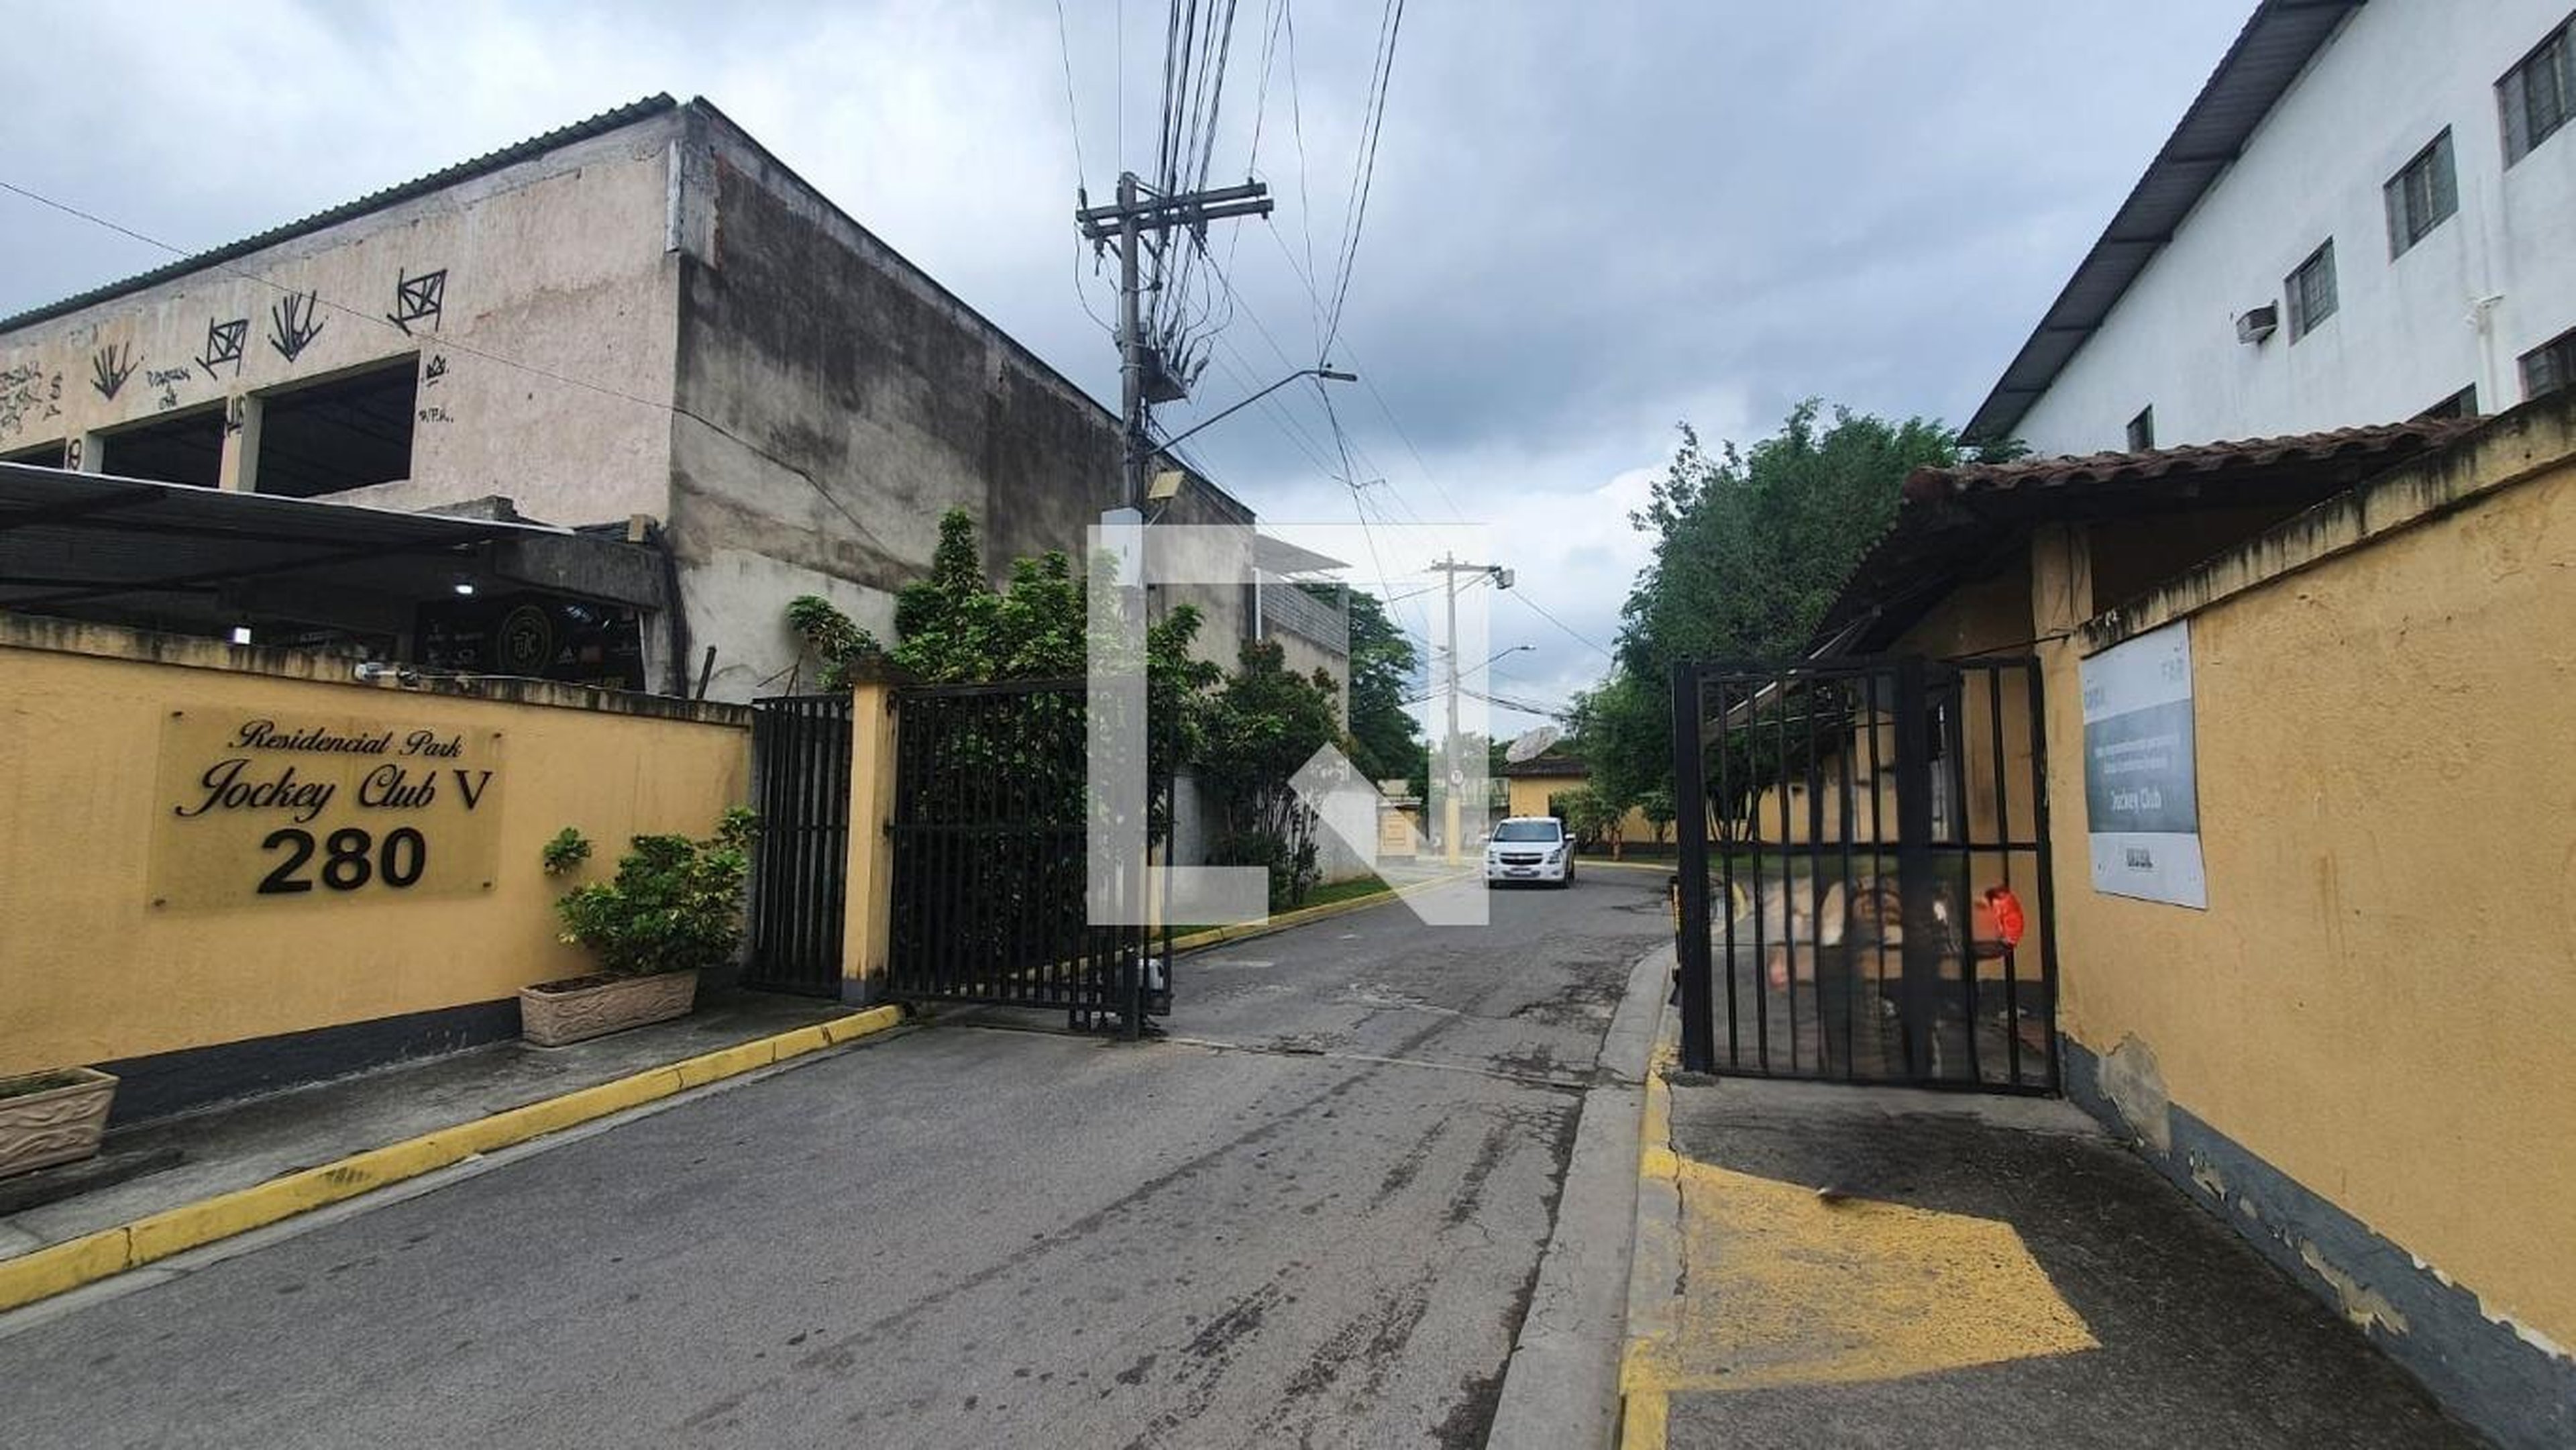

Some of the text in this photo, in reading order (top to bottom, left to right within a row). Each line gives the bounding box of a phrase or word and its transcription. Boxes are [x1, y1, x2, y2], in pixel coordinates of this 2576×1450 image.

[228, 720, 461, 758] Residencial Park
[176, 759, 493, 823] Jockey Club V
[257, 827, 425, 894] 280
